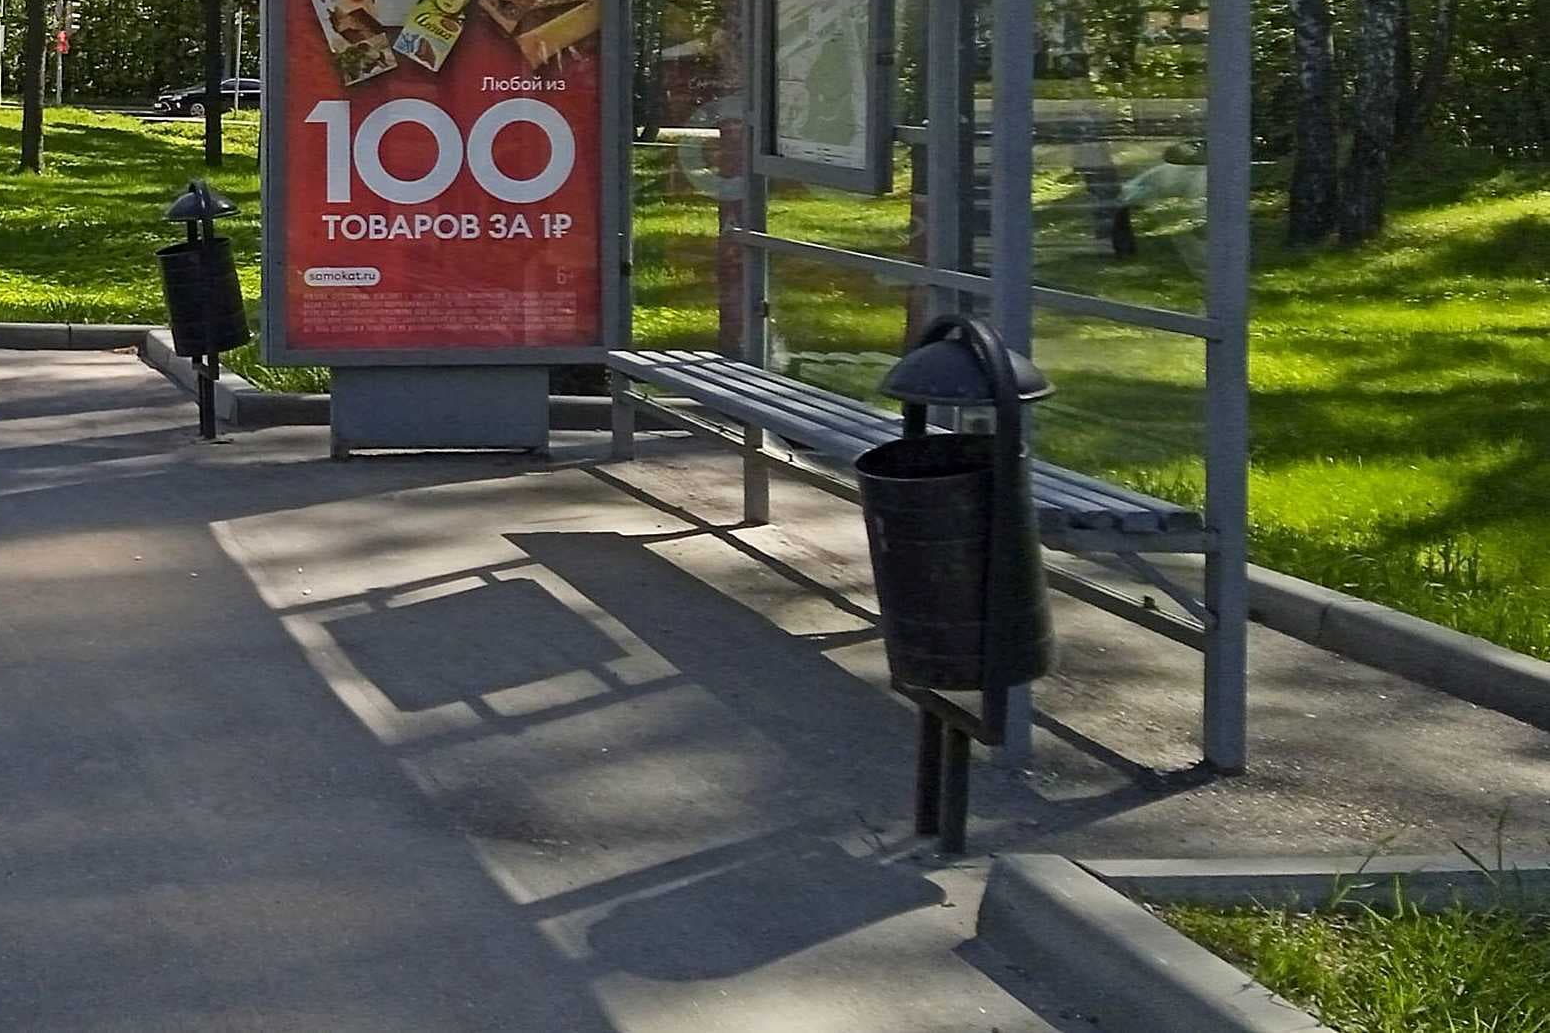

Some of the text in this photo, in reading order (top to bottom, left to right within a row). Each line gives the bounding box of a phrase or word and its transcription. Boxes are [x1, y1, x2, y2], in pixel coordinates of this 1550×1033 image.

[480, 75, 566, 92] Любой из
[304, 97, 576, 205] 100
[321, 213, 481, 240] ТОВАРОВ
[488, 214, 532, 239] ЗА
[309, 270, 376, 281] samokat.ru
